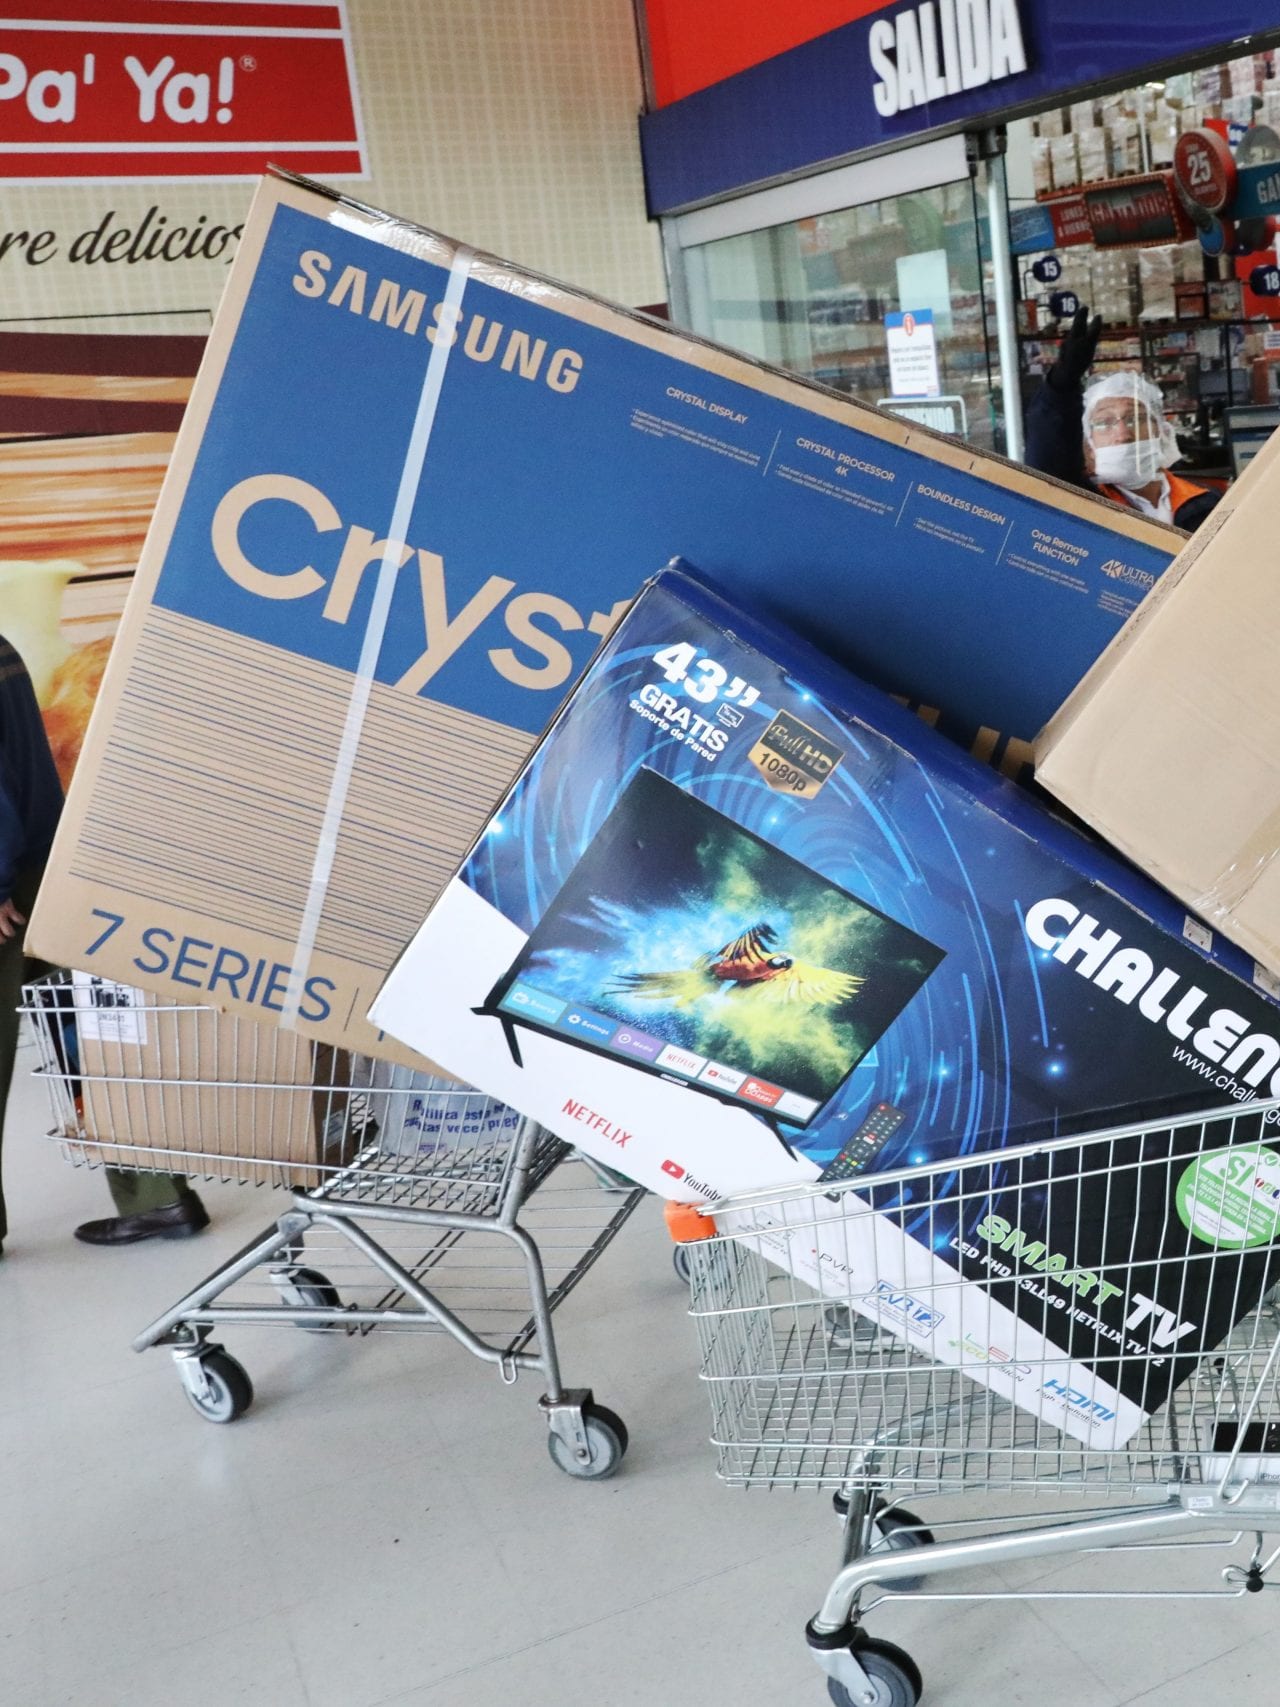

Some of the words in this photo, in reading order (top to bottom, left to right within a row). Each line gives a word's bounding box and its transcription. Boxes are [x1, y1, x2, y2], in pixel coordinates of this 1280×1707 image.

[867, 0, 1028, 118] SALIDA
[0, 53, 96, 124] Pa'
[124, 55, 235, 125] Ya!
[1187, 150, 1212, 186] 25
[1042, 261, 1058, 278] 15
[1263, 271, 1280, 291] 18
[293, 248, 585, 396] SAMSUNG
[1061, 297, 1076, 313] 16
[666, 386, 708, 410] CRYSTAL
[709, 402, 749, 425] DISPLAY
[796, 437, 837, 461] CRYSTAL
[837, 452, 896, 482] PROCESSOR
[835, 465, 849, 478] 4K
[917, 483, 971, 512] BOUNDLESS
[971, 503, 1006, 526] DESIGN
[1031, 529, 1051, 543] One
[1051, 537, 1090, 558] Remote
[1032, 541, 1081, 567] FUNCTION
[1121, 563, 1155, 586] ULTRA
[629, 699, 670, 732] Soporte
[670, 727, 685, 742] de
[684, 737, 718, 762] Pared
[639, 684, 730, 752] GRATIS
[766, 723, 806, 756] Full
[799, 745, 834, 774] HD
[759, 751, 807, 793] 1080p
[86, 908, 125, 957] 7
[133, 926, 338, 1024] SERIES
[666, 1053, 697, 1070] NETFLIX
[561, 1098, 633, 1149] NETFLIX
[949, 1237, 980, 1260] LED
[979, 1256, 1012, 1278] FHD
[1065, 1304, 1124, 1345] NETFLIX
[976, 1214, 1124, 1306] SMART
[1125, 1292, 1199, 1348] TV
[1043, 1378, 1120, 1422] HDMI
